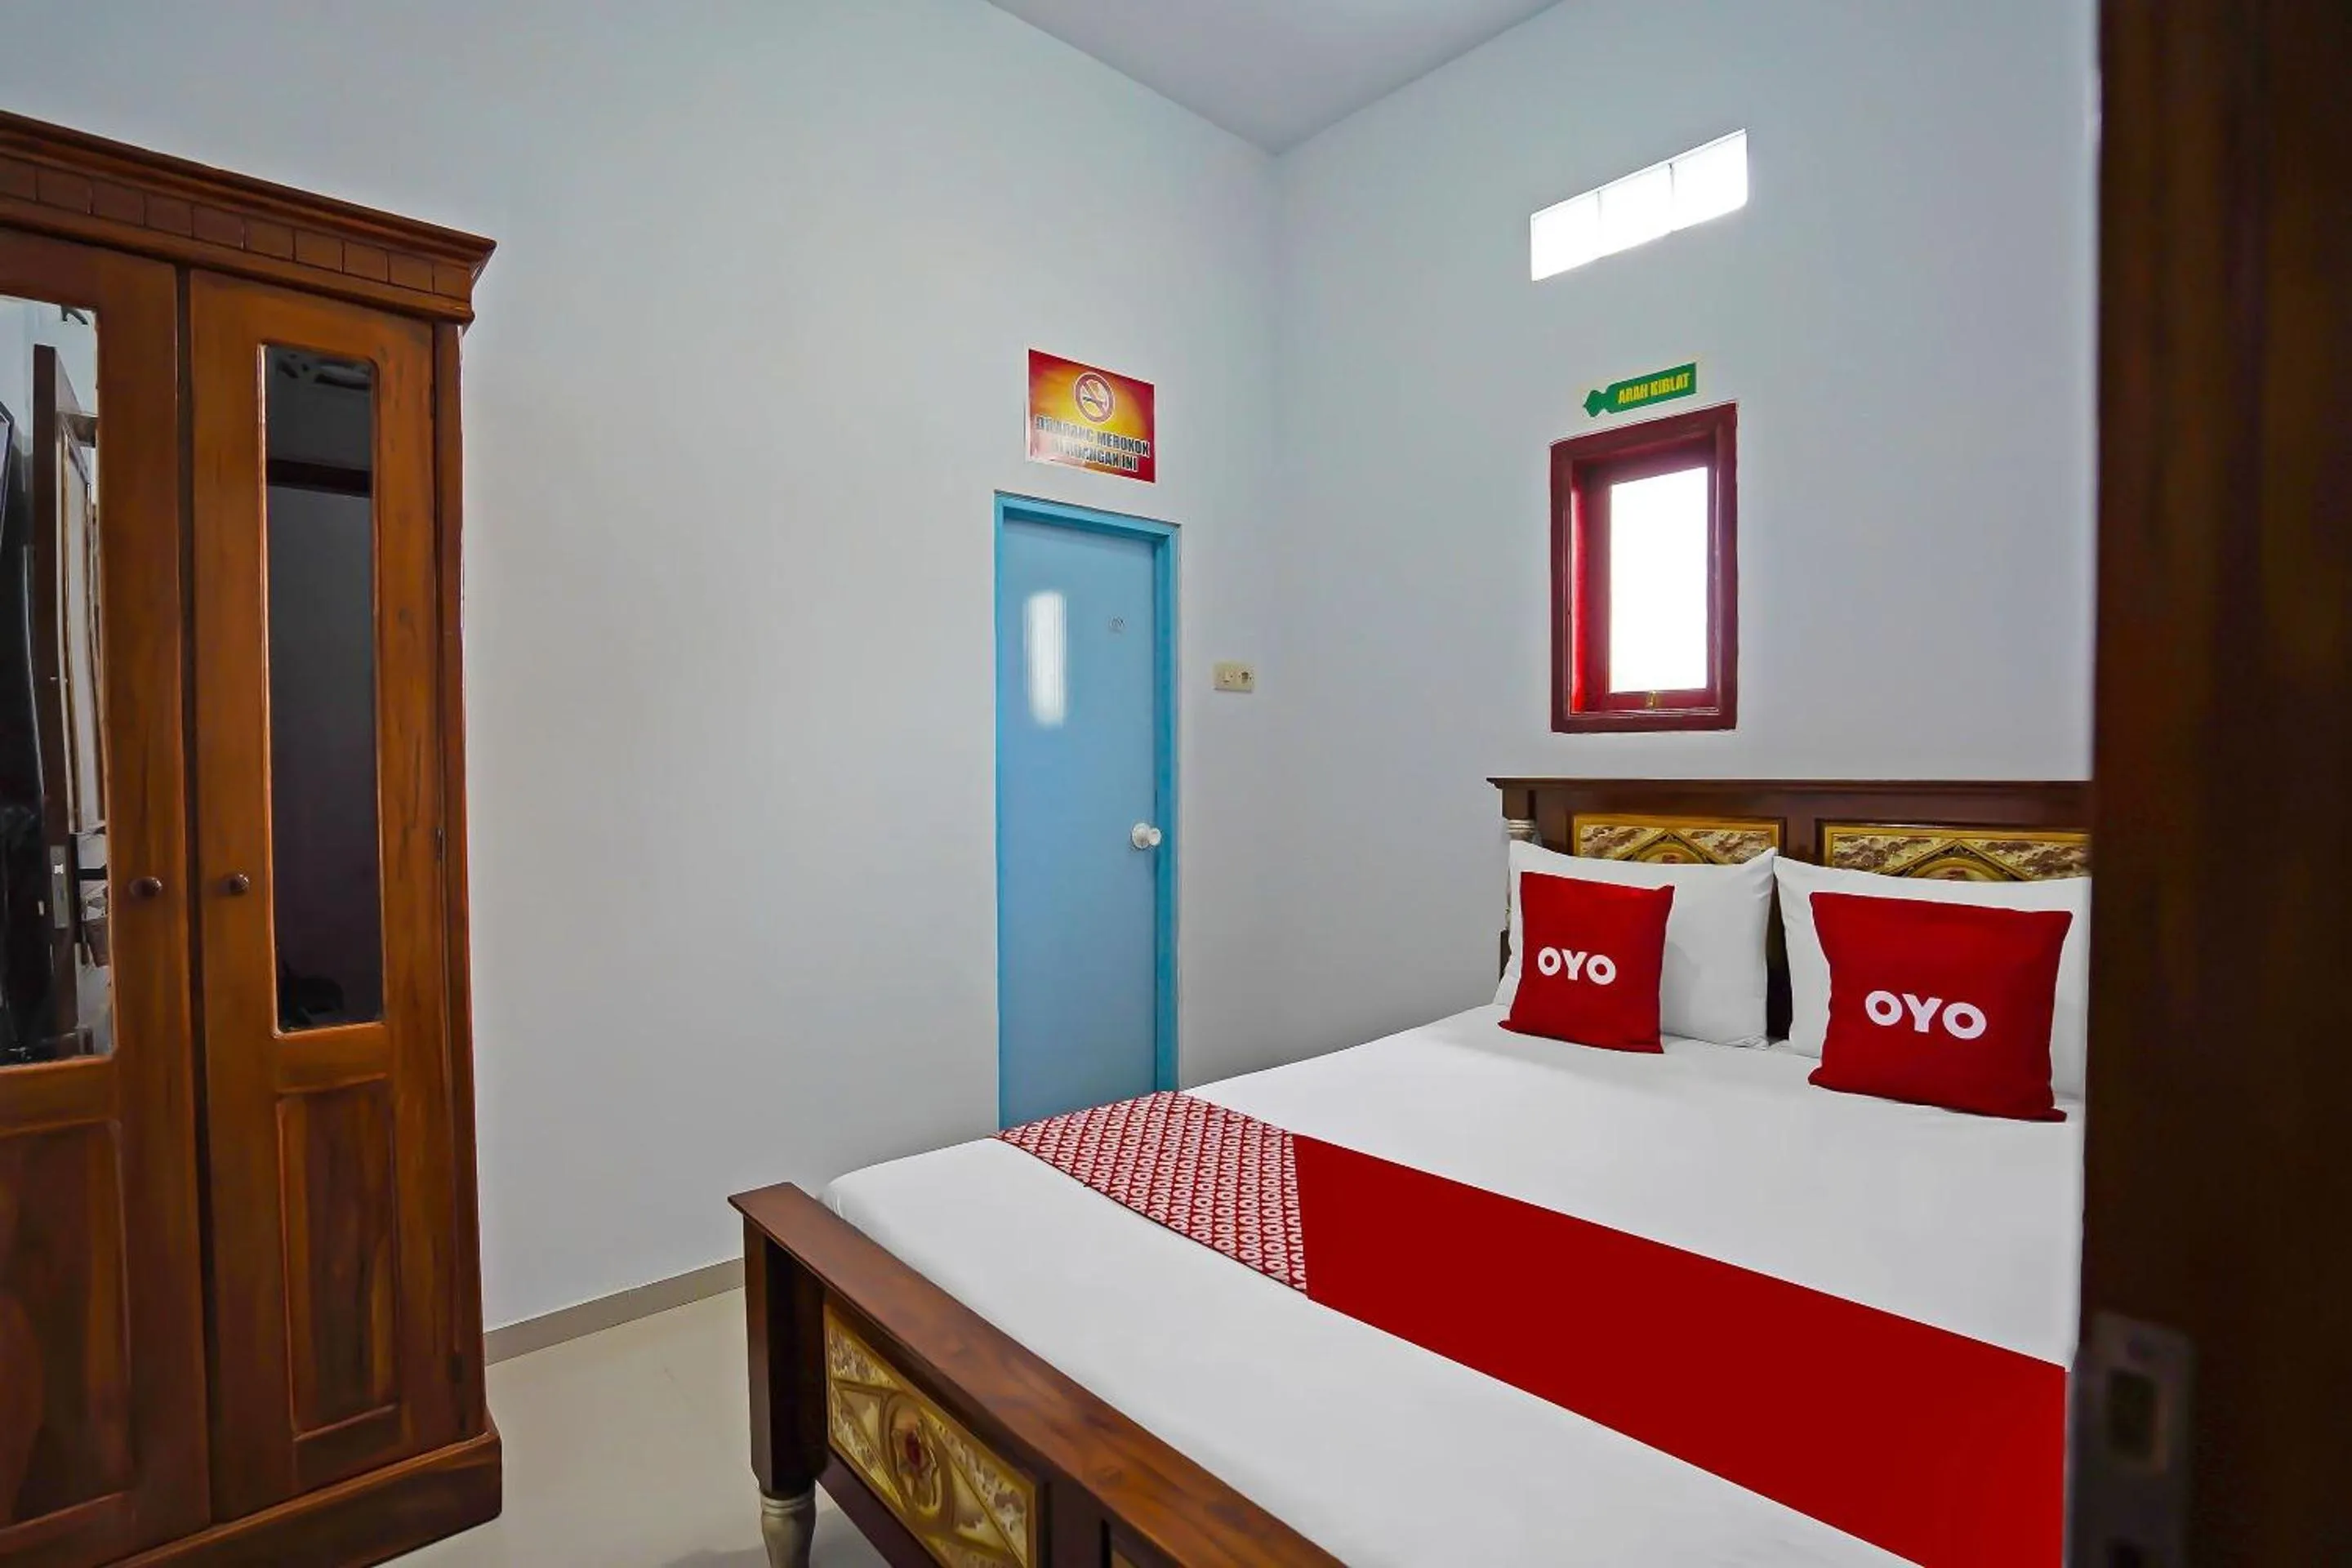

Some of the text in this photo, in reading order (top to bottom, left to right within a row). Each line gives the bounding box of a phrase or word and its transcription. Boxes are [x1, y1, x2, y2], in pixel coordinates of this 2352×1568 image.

[1618, 373, 1690, 404] ARAH KIBLAT
[1097, 430, 1150, 457] MEROKOK
[1120, 453, 1138, 472] INI
[1538, 947, 1616, 985] OYO
[1865, 990, 1987, 1040] OYO
